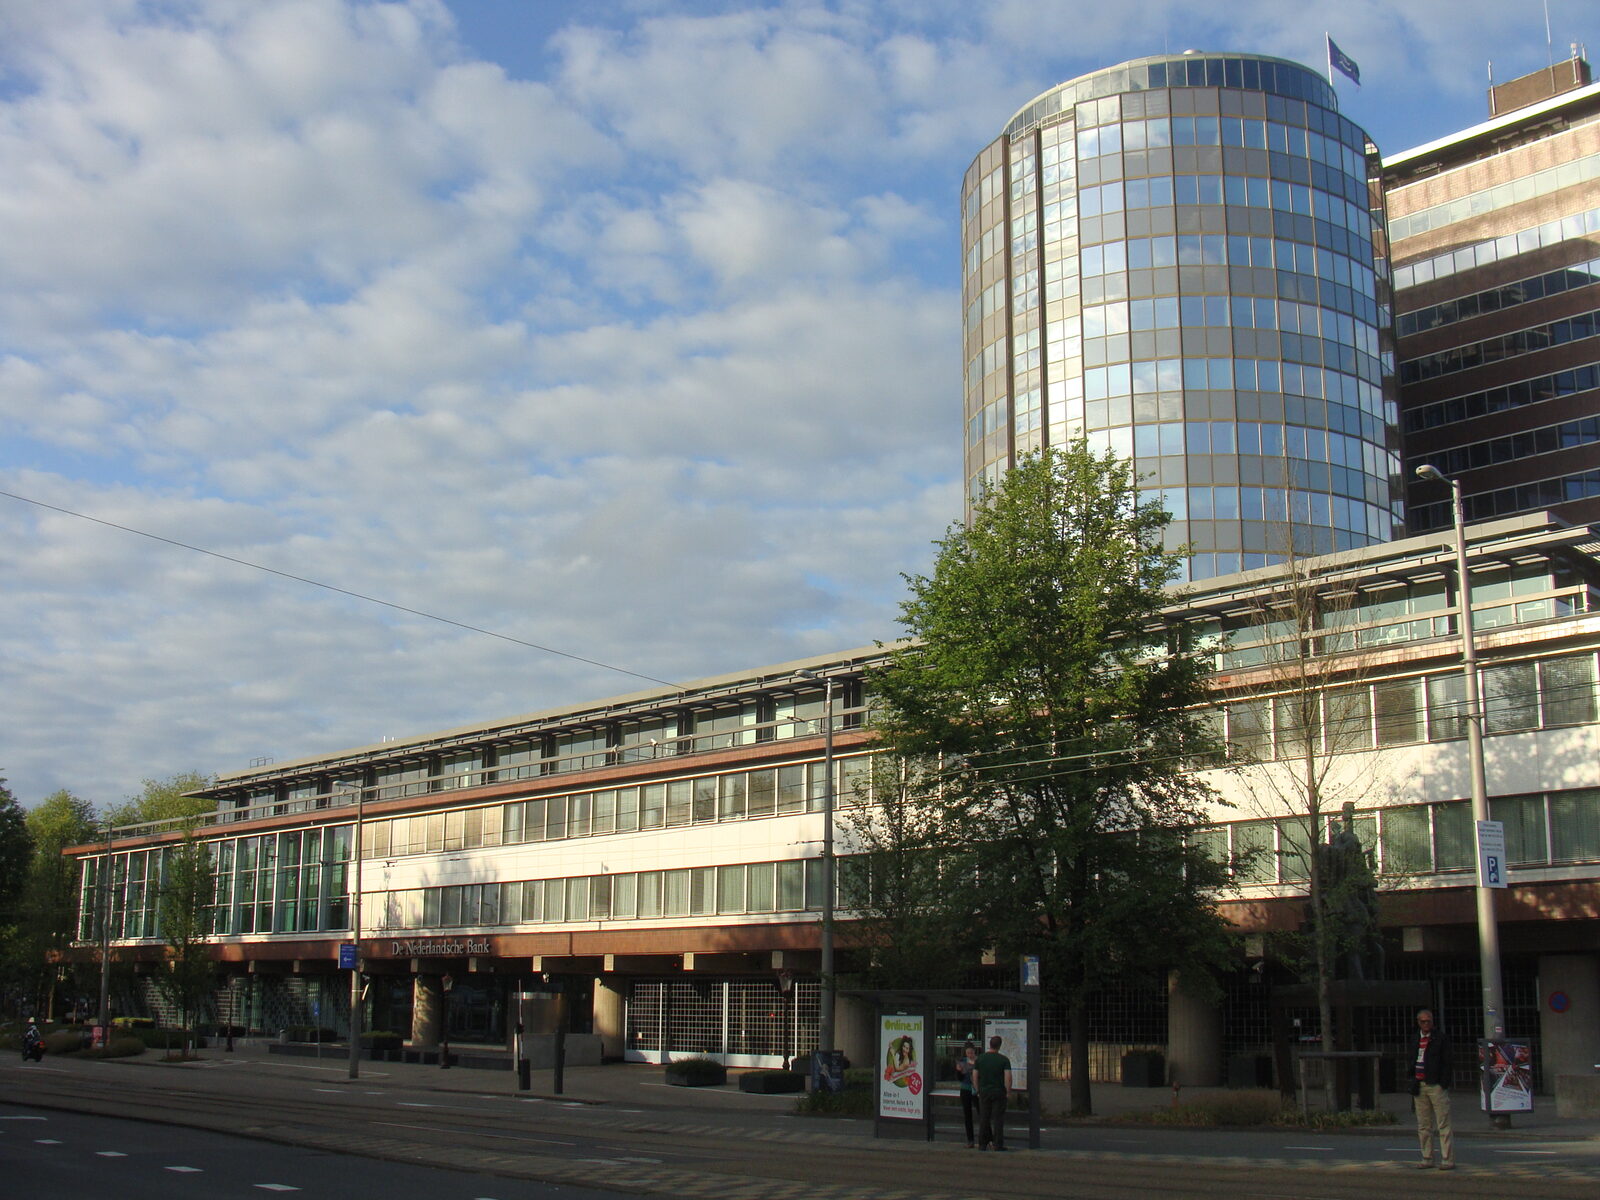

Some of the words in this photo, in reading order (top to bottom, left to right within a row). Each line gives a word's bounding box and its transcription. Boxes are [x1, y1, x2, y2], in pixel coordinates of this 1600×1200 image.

[1489, 857, 1496, 872] P
[392, 941, 403, 955] De
[405, 939, 464, 955] Nederlandsche
[467, 937, 490, 954] Bank
[884, 1019, 922, 1031] Online.nl
